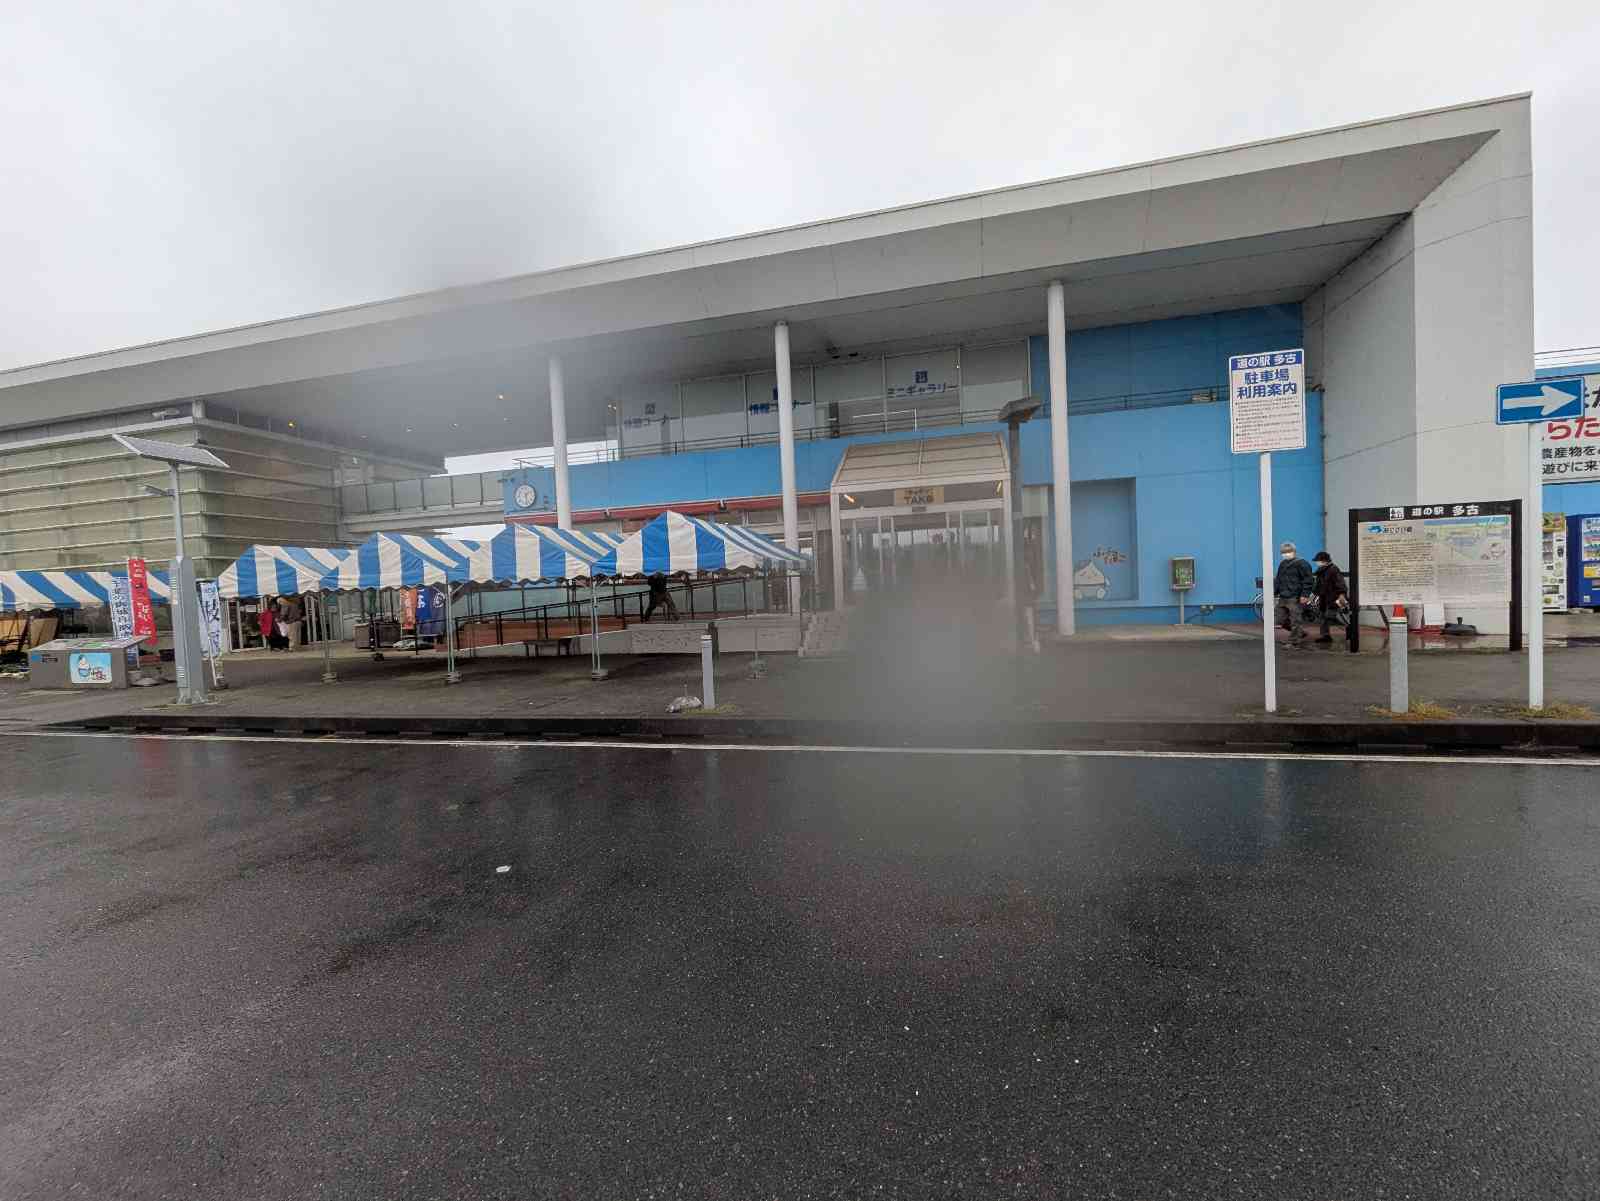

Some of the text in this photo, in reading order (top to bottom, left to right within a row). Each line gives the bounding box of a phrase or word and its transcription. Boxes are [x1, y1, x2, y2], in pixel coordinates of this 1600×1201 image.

[1236, 353, 1297, 369] 道の駅 多古
[1244, 368, 1289, 385] 駐車場
[887, 382, 959, 399] ミニギャラリー
[1237, 382, 1297, 399] 利用案内
[1541, 445, 1600, 459] 農産物を
[1541, 460, 1600, 475] 遊びに来
[1412, 504, 1480, 516] 道の駅 多古
